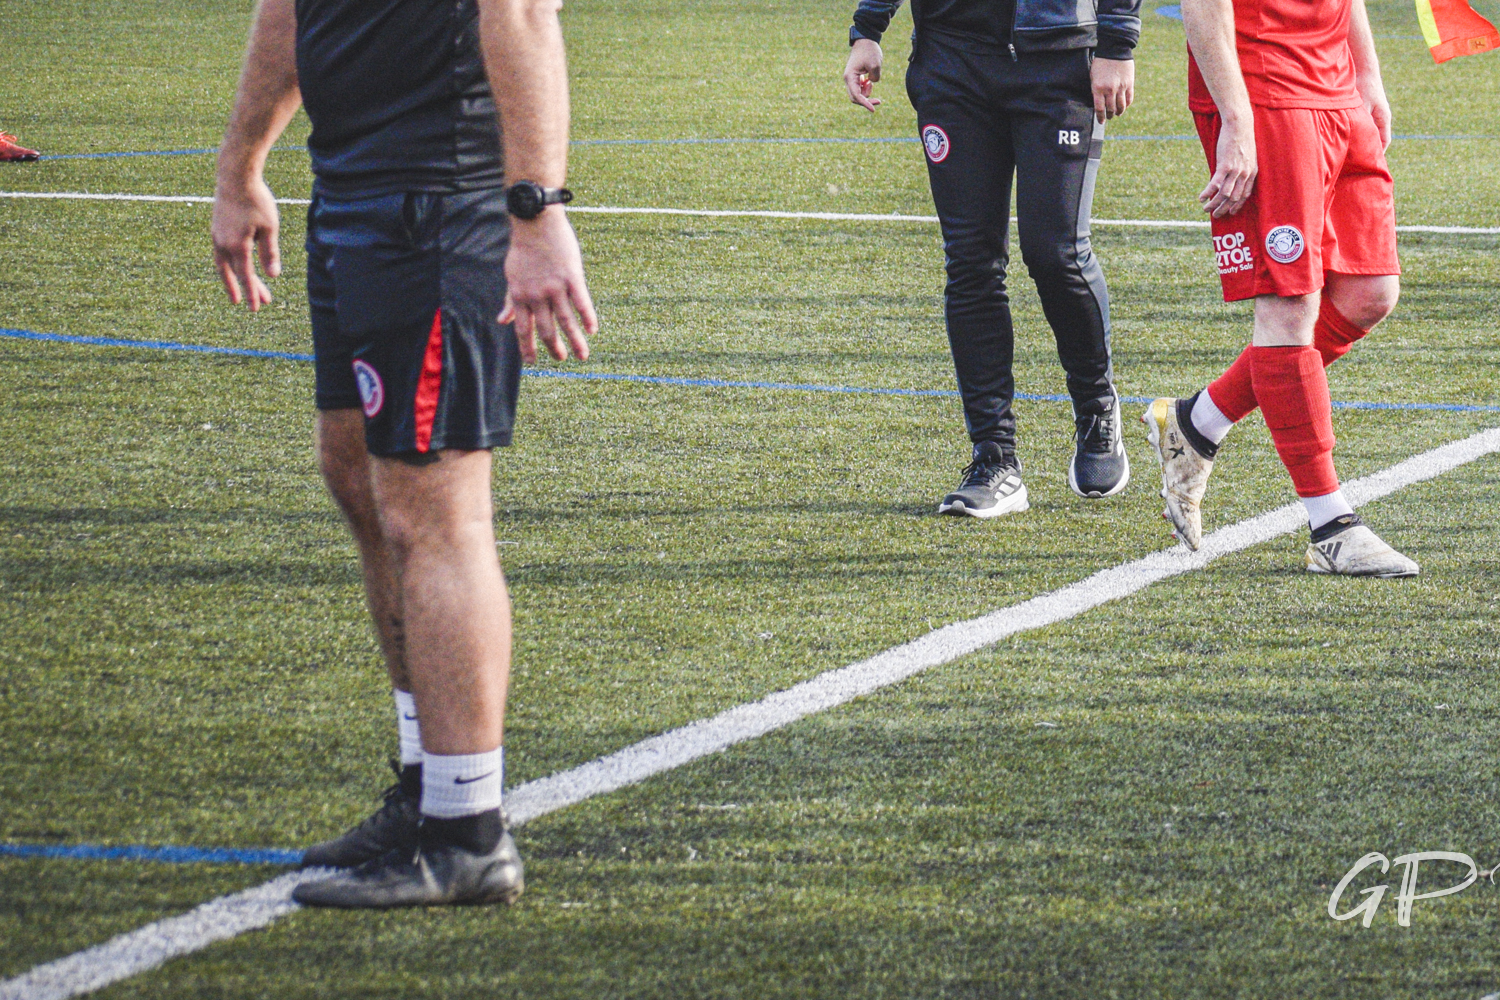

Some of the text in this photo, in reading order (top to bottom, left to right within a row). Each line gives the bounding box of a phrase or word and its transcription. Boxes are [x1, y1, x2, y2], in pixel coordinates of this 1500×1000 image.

[1058, 130, 1080, 145] RB
[1212, 231, 1245, 251] TOP
[1215, 246, 1254, 267] 2TOE
[1218, 266, 1239, 275] eauty
